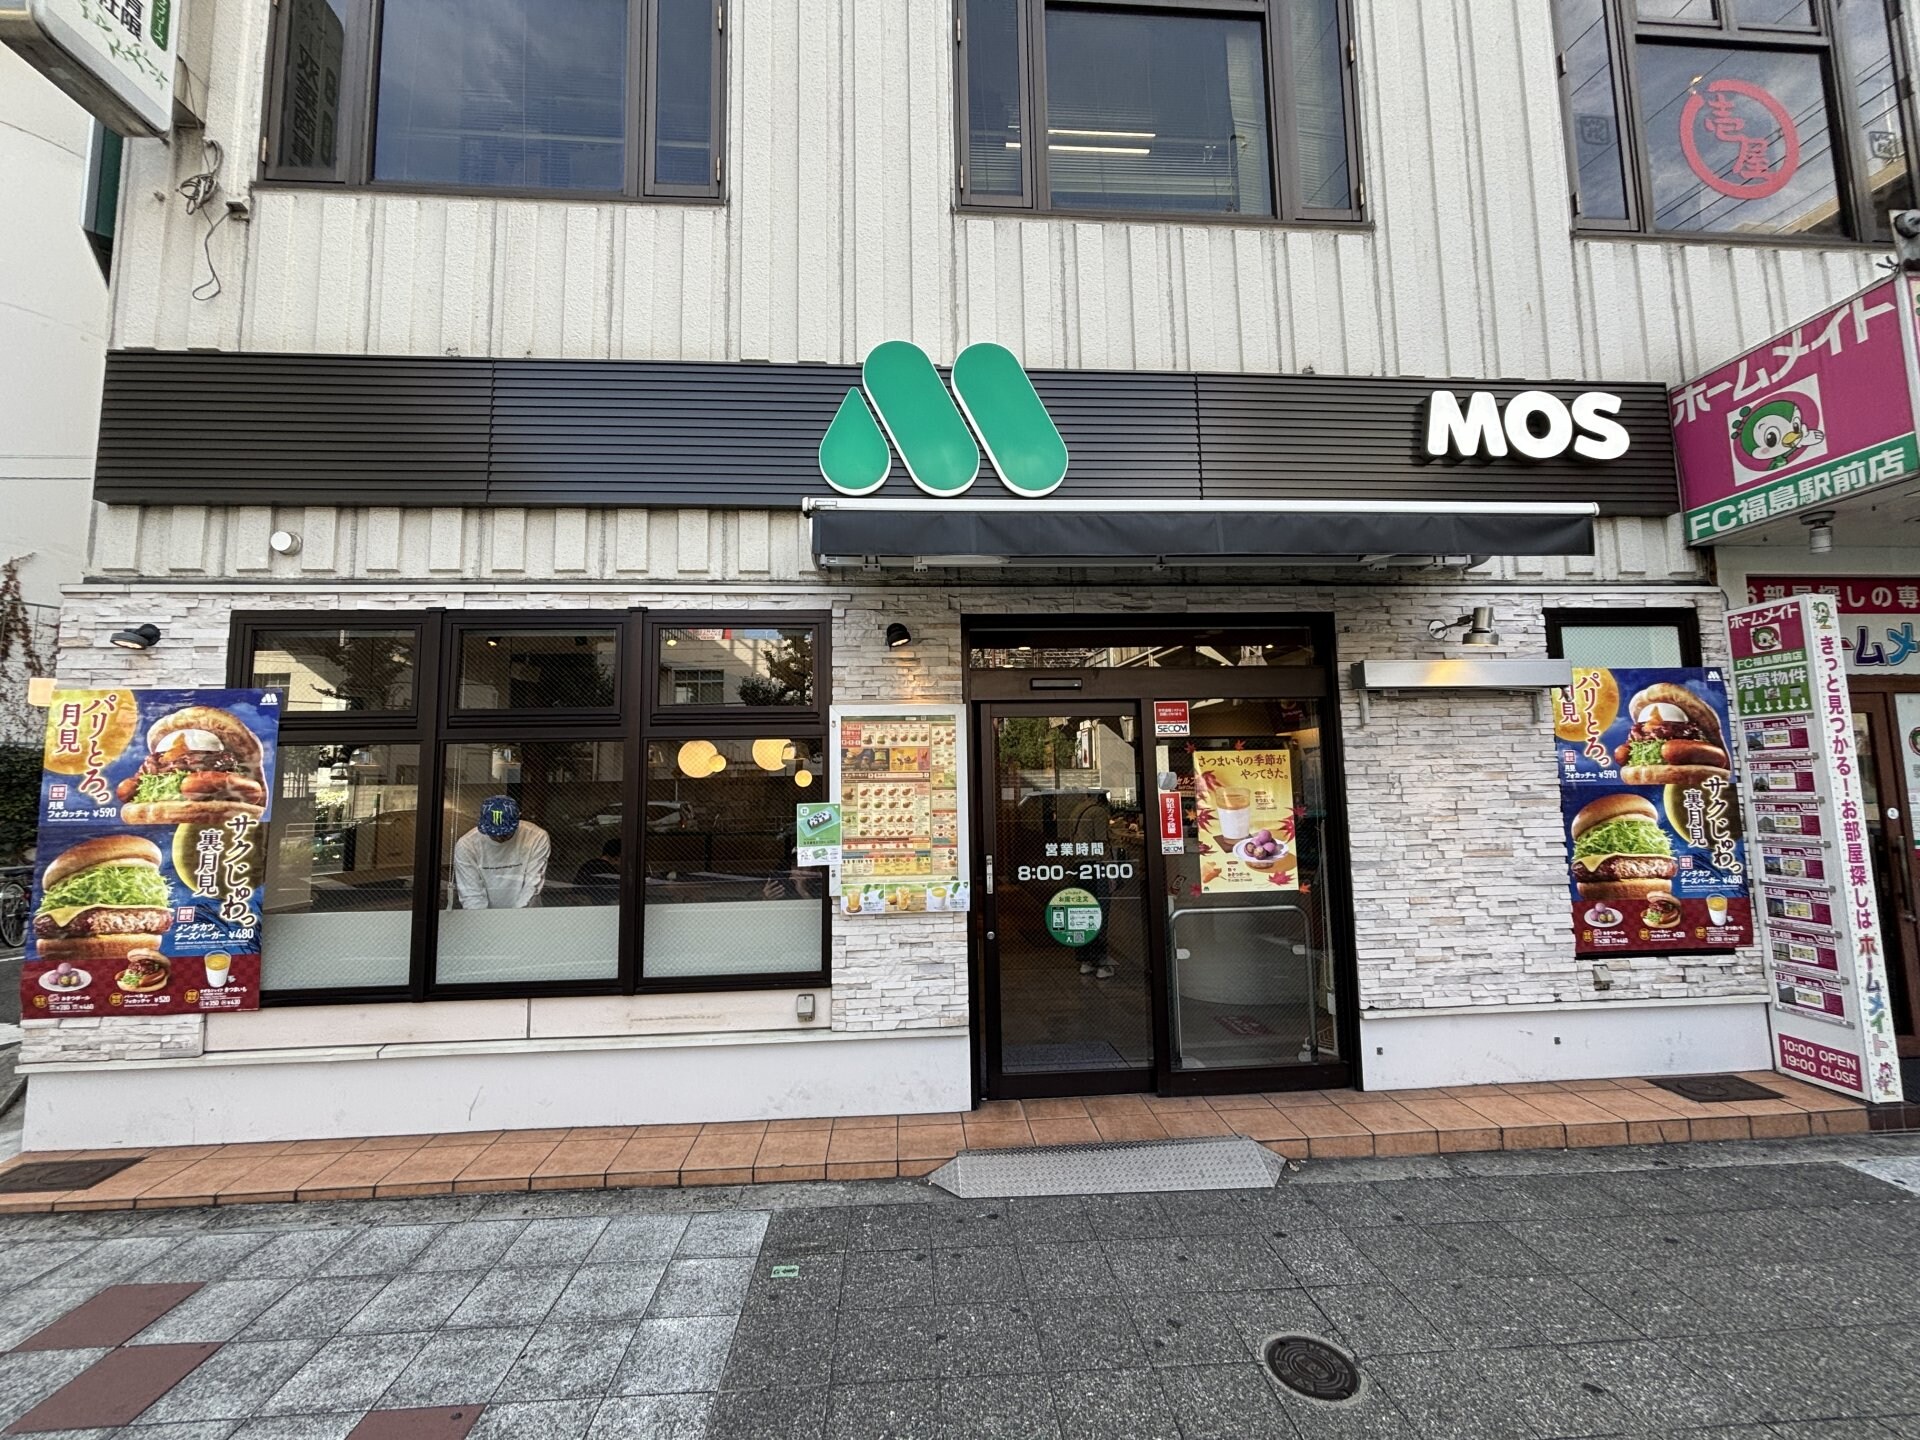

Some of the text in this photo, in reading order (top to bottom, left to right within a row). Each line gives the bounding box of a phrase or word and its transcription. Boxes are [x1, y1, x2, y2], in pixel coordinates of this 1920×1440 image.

[1672, 297, 1896, 427] ホームメイト
[1425, 390, 1631, 461] MOS
[1689, 447, 1905, 540] FC福島駅前店
[1729, 604, 1800, 629] ホームメイト
[1736, 651, 1804, 669] FC福島駅前店
[1841, 622, 1920, 667] ムメ
[1737, 667, 1807, 690] 売買物件
[56, 703, 81, 754] 月見
[1157, 724, 1188, 733] SECOM
[1576, 672, 1610, 766] パリとろっ
[79, 693, 117, 803] パリとろっ
[1198, 753, 1286, 767] さつまいもの季節が
[1240, 768, 1289, 780] やってきた。
[47, 807, 117, 818] フォカッチャ ¥590
[1685, 790, 1708, 847] 裏月見
[1704, 776, 1743, 872] サクじゅわっ
[195, 829, 224, 897] 裏月見
[1045, 842, 1104, 857] 営業時間
[220, 815, 257, 927] サクじゅわっ
[1680, 876, 1721, 885] チーズバーガー
[174, 928, 254, 941] チーズバーガー ¥480
[175, 923, 215, 932] メンチカツ
[1858, 935, 1889, 1056] ホームメイト
[1782, 1039, 1857, 1070] 10:00 OPEN
[1784, 1054, 1858, 1086] 19:00 CLOSE
